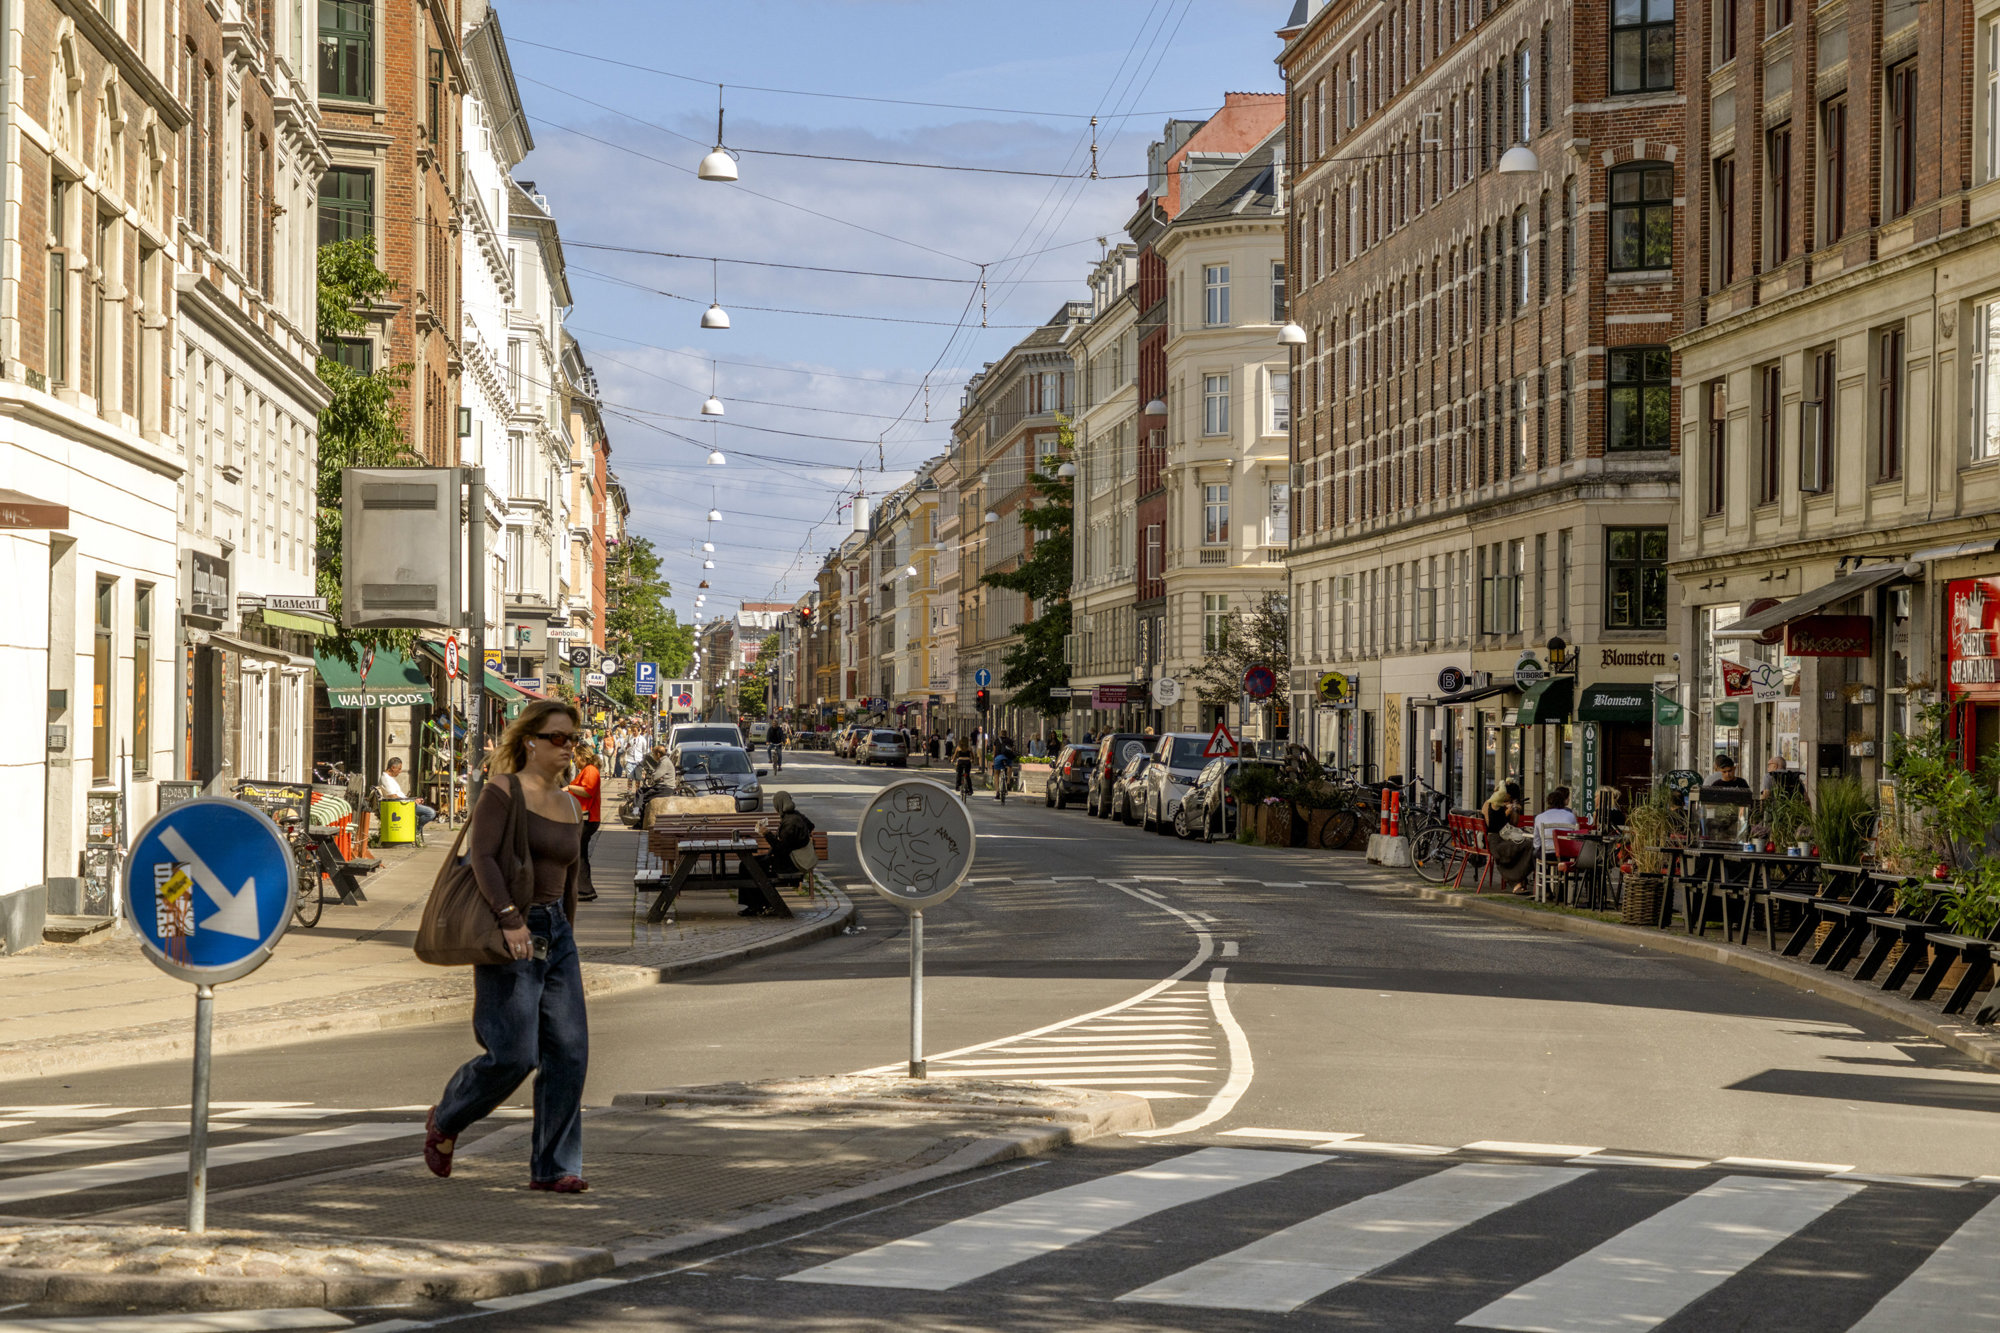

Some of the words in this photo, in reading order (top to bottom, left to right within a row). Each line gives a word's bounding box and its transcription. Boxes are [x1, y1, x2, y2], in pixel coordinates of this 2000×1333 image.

[550, 629, 579, 638] danbolig
[1961, 632, 1986, 656] SHEIK
[1600, 648, 1665, 669] Blomsten
[640, 664, 652, 681] P
[1516, 671, 1544, 679] TUBORG
[1951, 659, 1996, 684] SHAWARMA
[1442, 672, 1456, 689] B
[338, 694, 377, 706] WALD
[379, 693, 425, 705] FOODS
[1592, 694, 1642, 708] Blomsten
